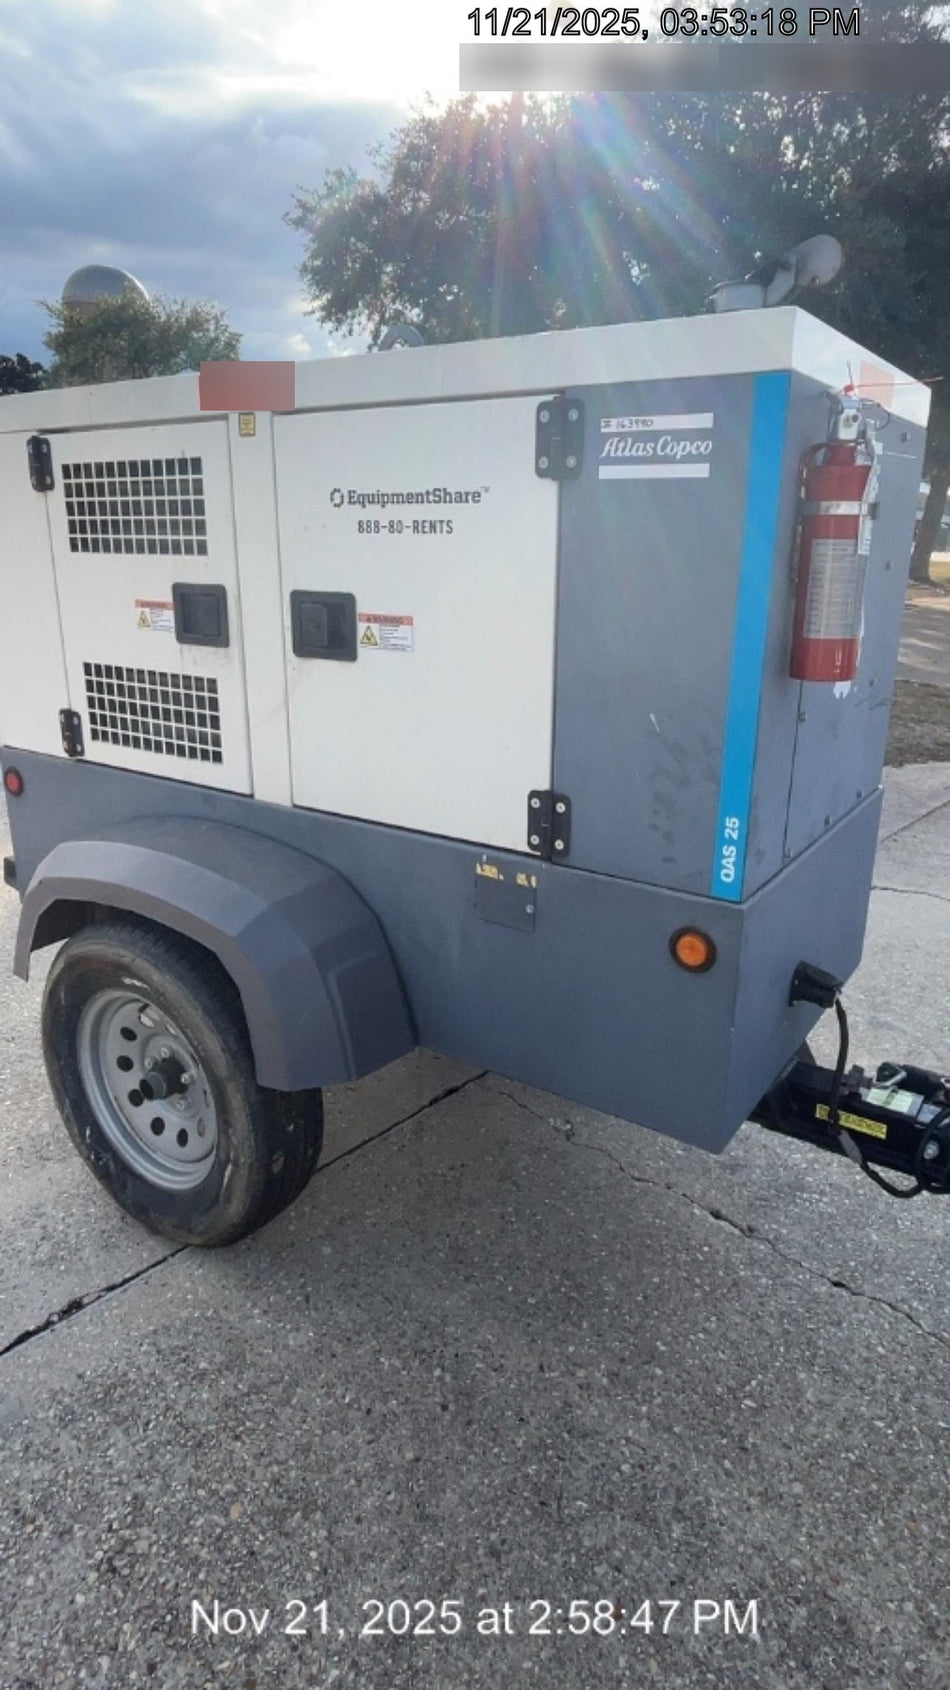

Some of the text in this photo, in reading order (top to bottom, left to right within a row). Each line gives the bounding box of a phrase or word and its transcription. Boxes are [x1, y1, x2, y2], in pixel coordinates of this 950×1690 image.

[600, 435, 713, 460] Atlas Copco
[357, 519, 454, 534] 888-80-RENTS
[724, 816, 740, 840] 25
